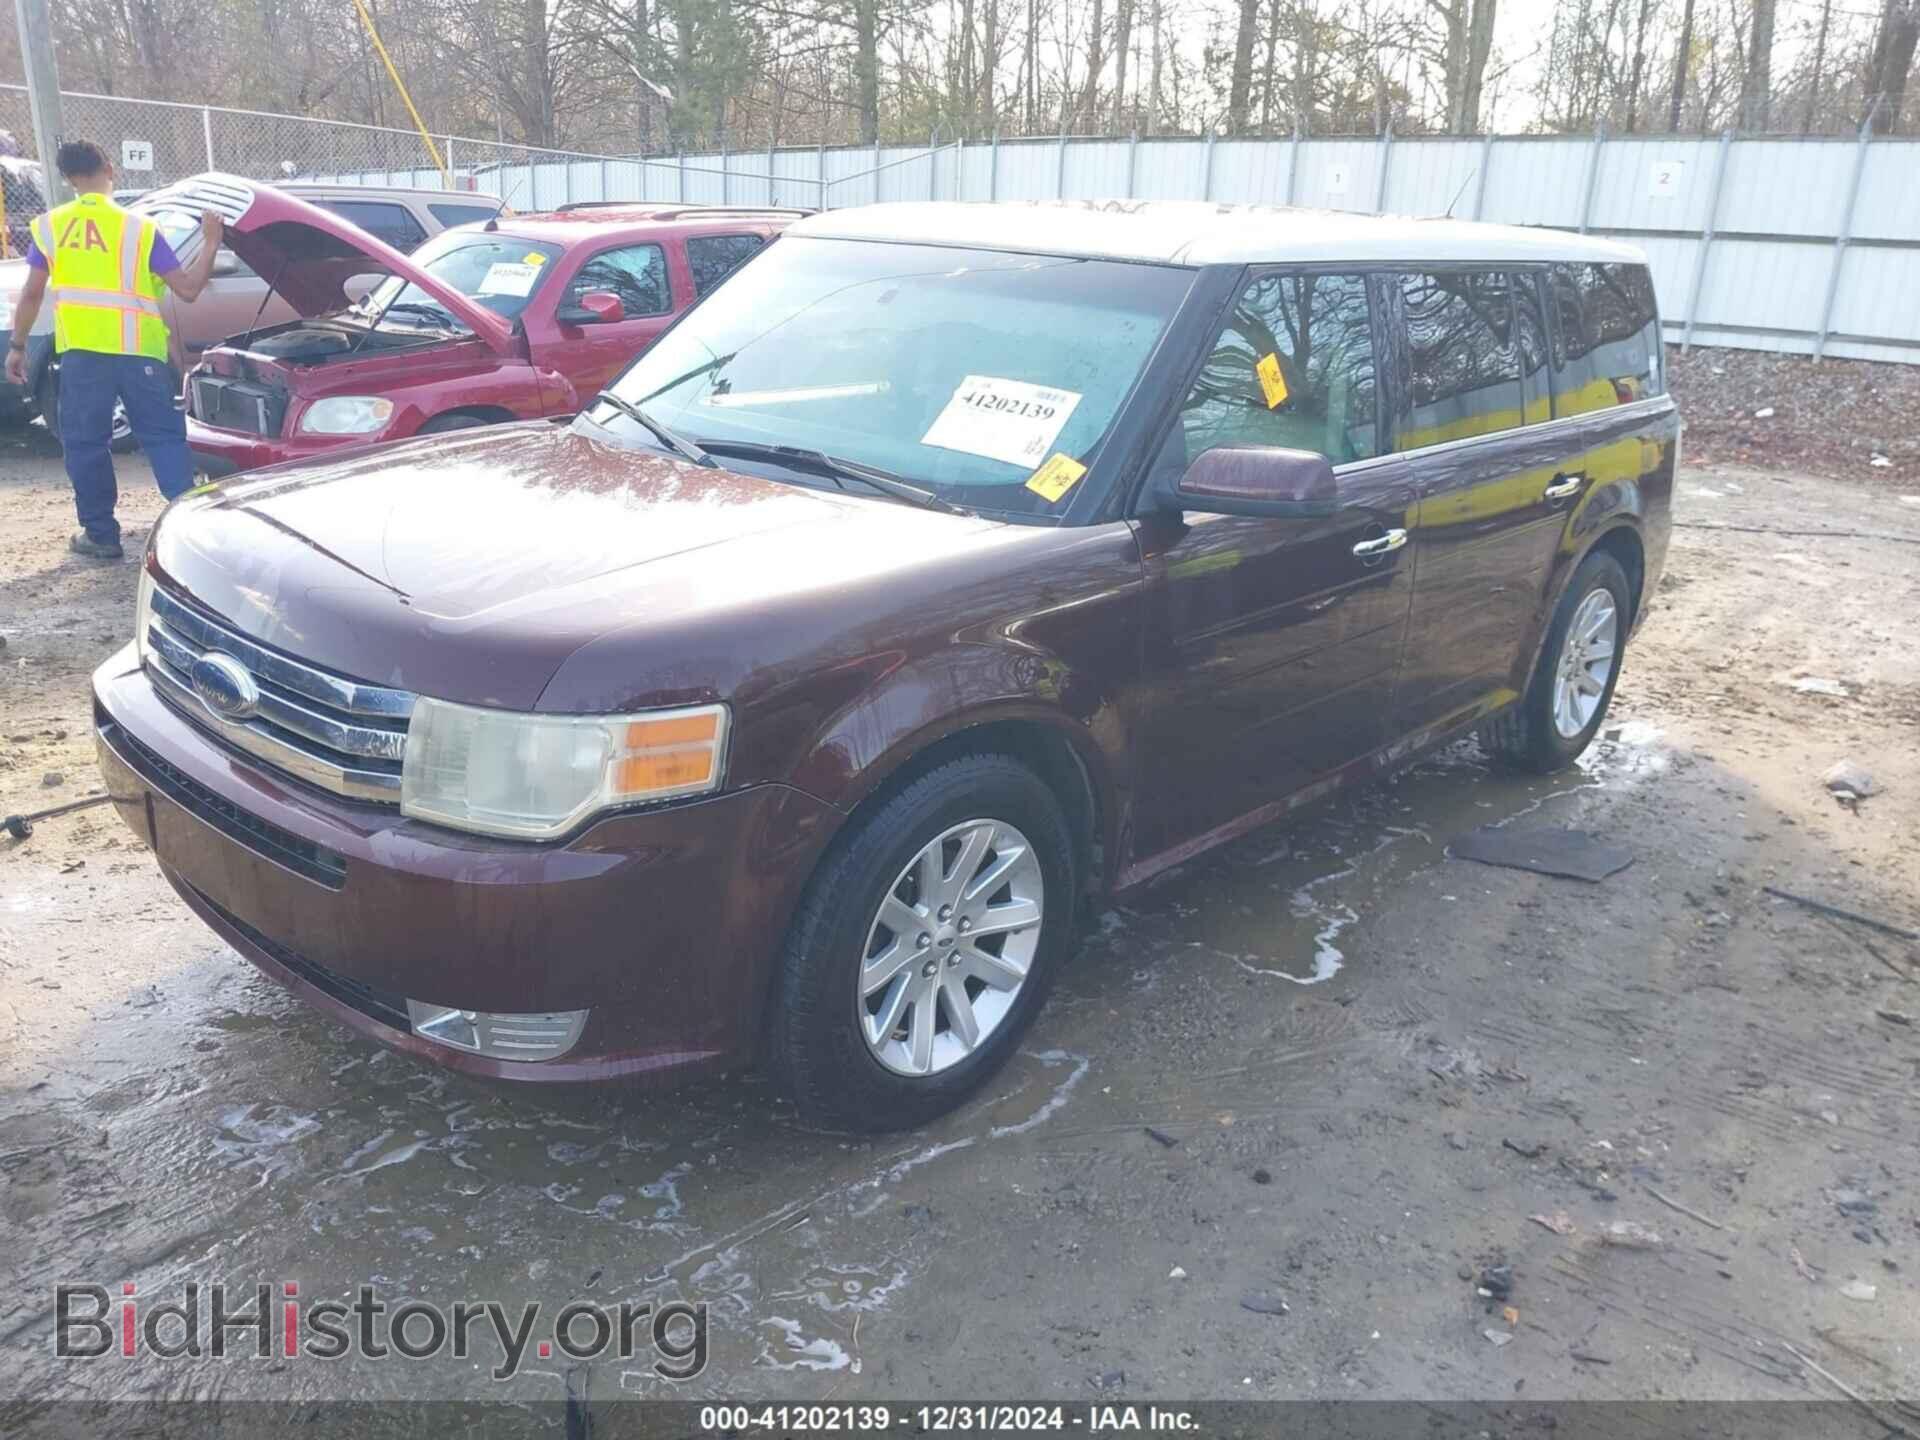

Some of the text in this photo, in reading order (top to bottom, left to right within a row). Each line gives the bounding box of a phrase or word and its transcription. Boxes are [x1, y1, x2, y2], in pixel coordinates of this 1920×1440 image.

[129, 150, 147, 160] FF
[1659, 172, 1670, 184] 2
[963, 391, 1056, 421] 41202139
